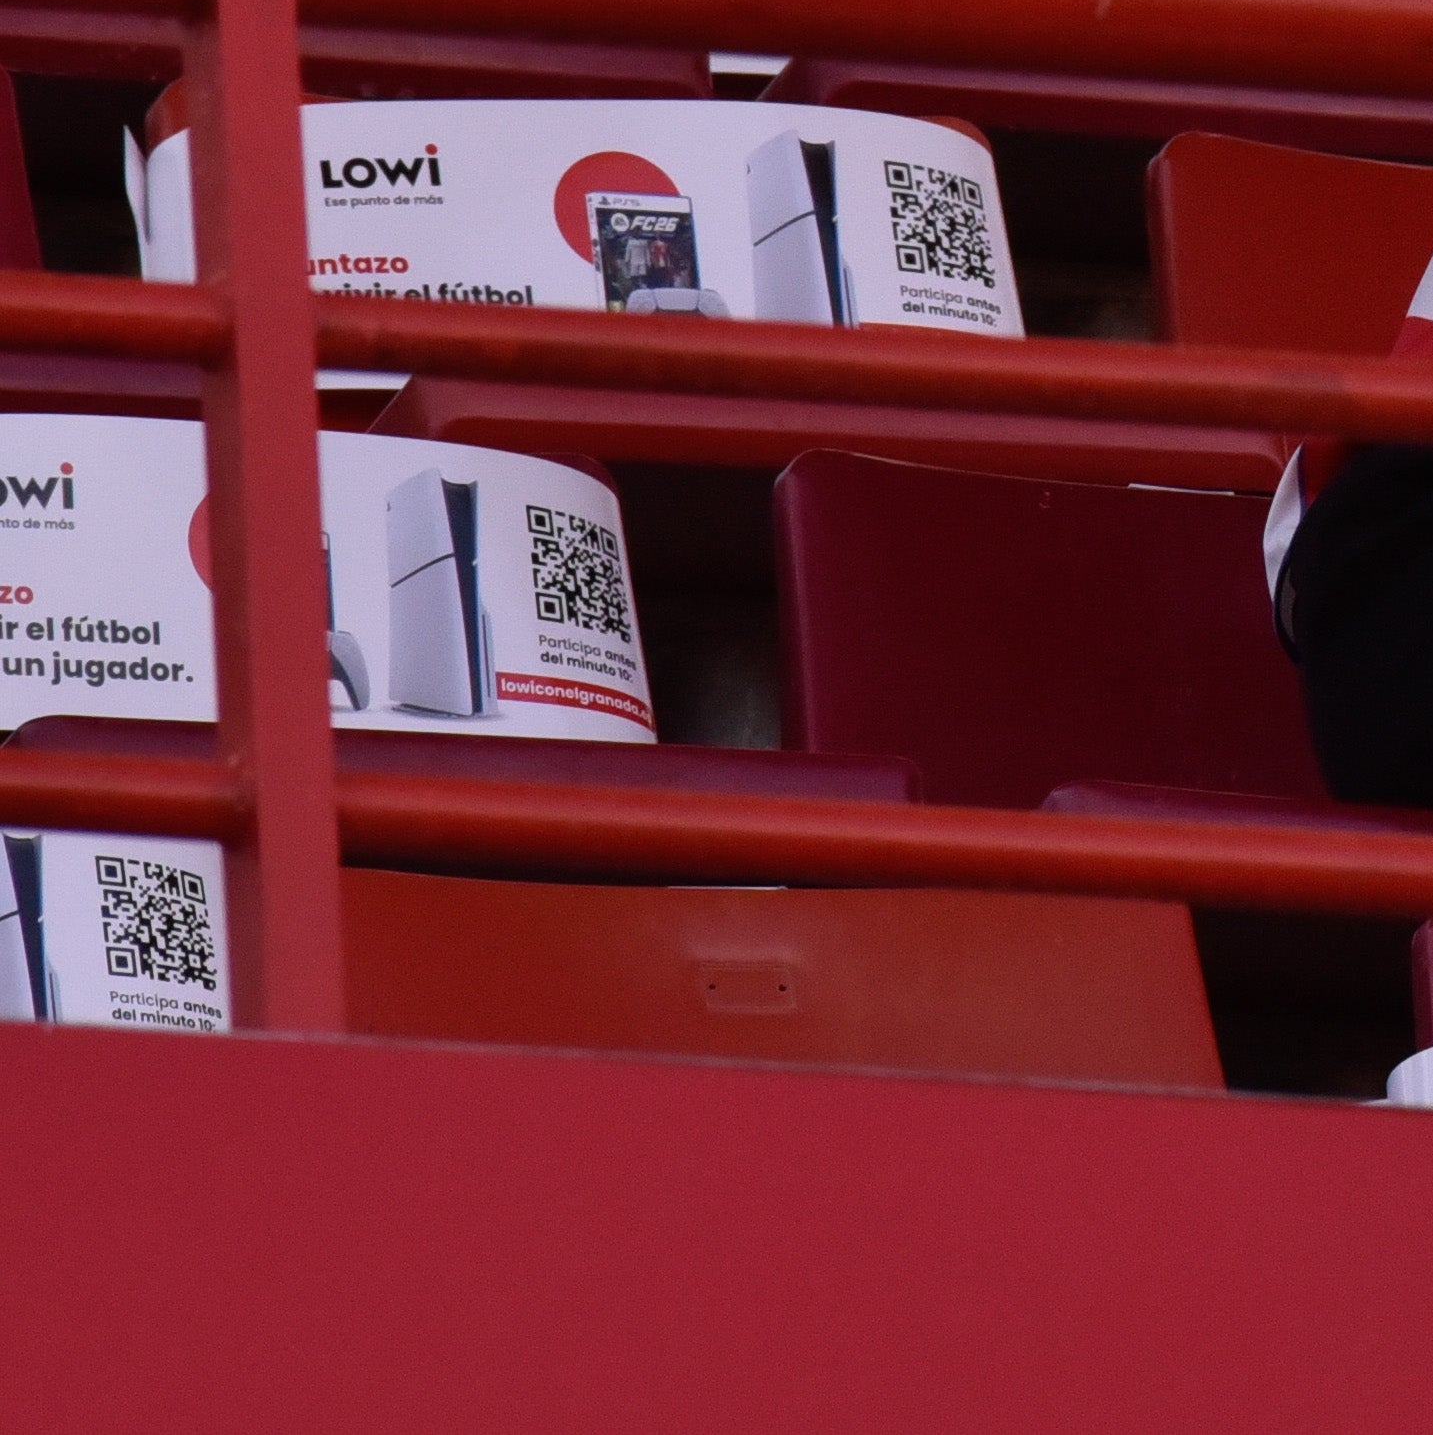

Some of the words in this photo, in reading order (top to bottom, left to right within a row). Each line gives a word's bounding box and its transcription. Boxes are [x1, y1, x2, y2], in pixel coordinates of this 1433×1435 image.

[324, 197, 347, 207] Ese
[351, 195, 391, 209] punto
[393, 195, 411, 205] de
[414, 194, 444, 205] más
[305, 253, 409, 275] untazo
[900, 285, 963, 304] Participa
[966, 296, 1002, 315] antes
[902, 301, 925, 313] del
[928, 305, 979, 323] minuto
[23, 518, 41, 529] de
[44, 518, 75, 530] más
[26, 617, 54, 641] el
[62, 616, 161, 645] fútbol
[539, 634, 601, 657] Participa
[605, 649, 637, 671] antes
[540, 651, 563, 664] del
[567, 656, 616, 676] minuto
[2, 657, 45, 677] un
[51, 651, 194, 687] jugador.
[110, 991, 179, 1011] Participa
[183, 1001, 223, 1019] antes
[112, 1008, 137, 1022] del
[140, 1010, 196, 1029] minuto
